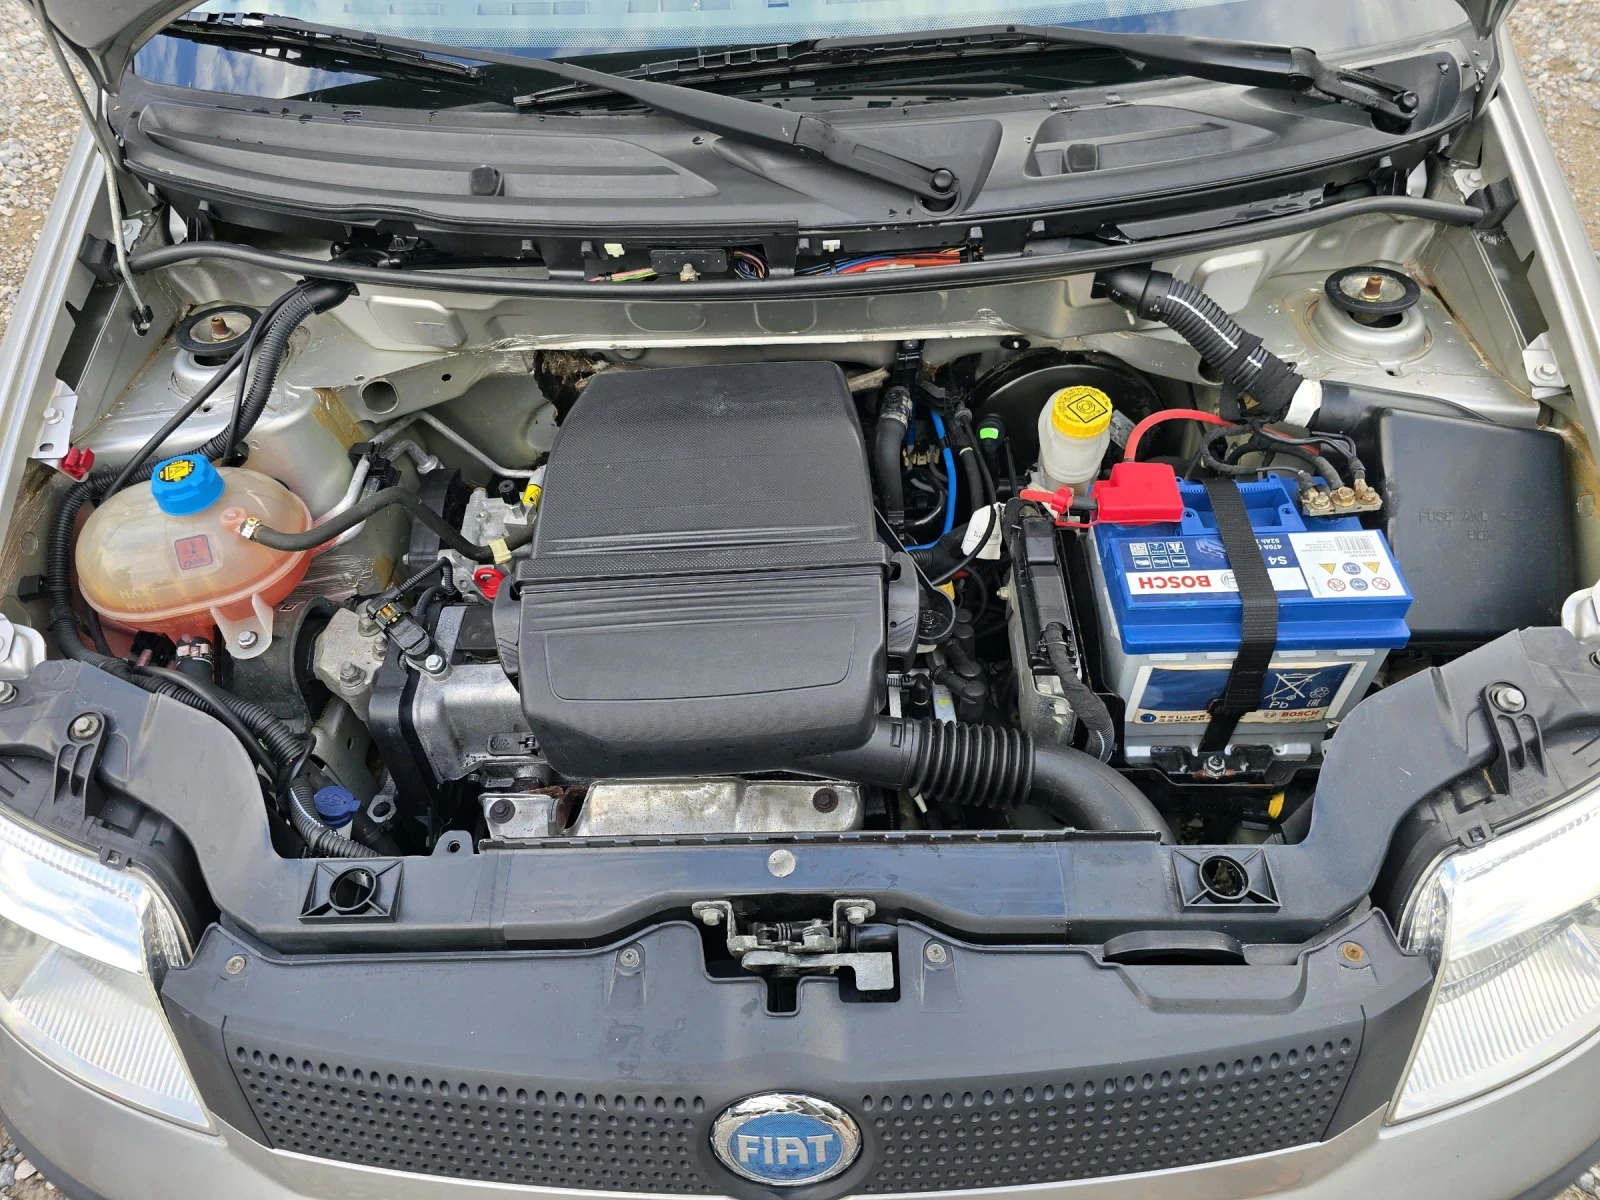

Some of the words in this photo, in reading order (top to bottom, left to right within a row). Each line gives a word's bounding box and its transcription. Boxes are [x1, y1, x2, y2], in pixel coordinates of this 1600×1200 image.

[1418, 509, 1453, 522] FUSE
[1462, 509, 1489, 522] AND
[1467, 528, 1493, 541] BOX
[1267, 556, 1288, 565] S4
[1138, 575, 1212, 591] BOSCH
[118, 587, 153, 599] MAX
[126, 602, 158, 612] MIN
[1268, 701, 1289, 709] Pb
[1281, 709, 1320, 718] BOSCH
[737, 1133, 834, 1165] FIAT
